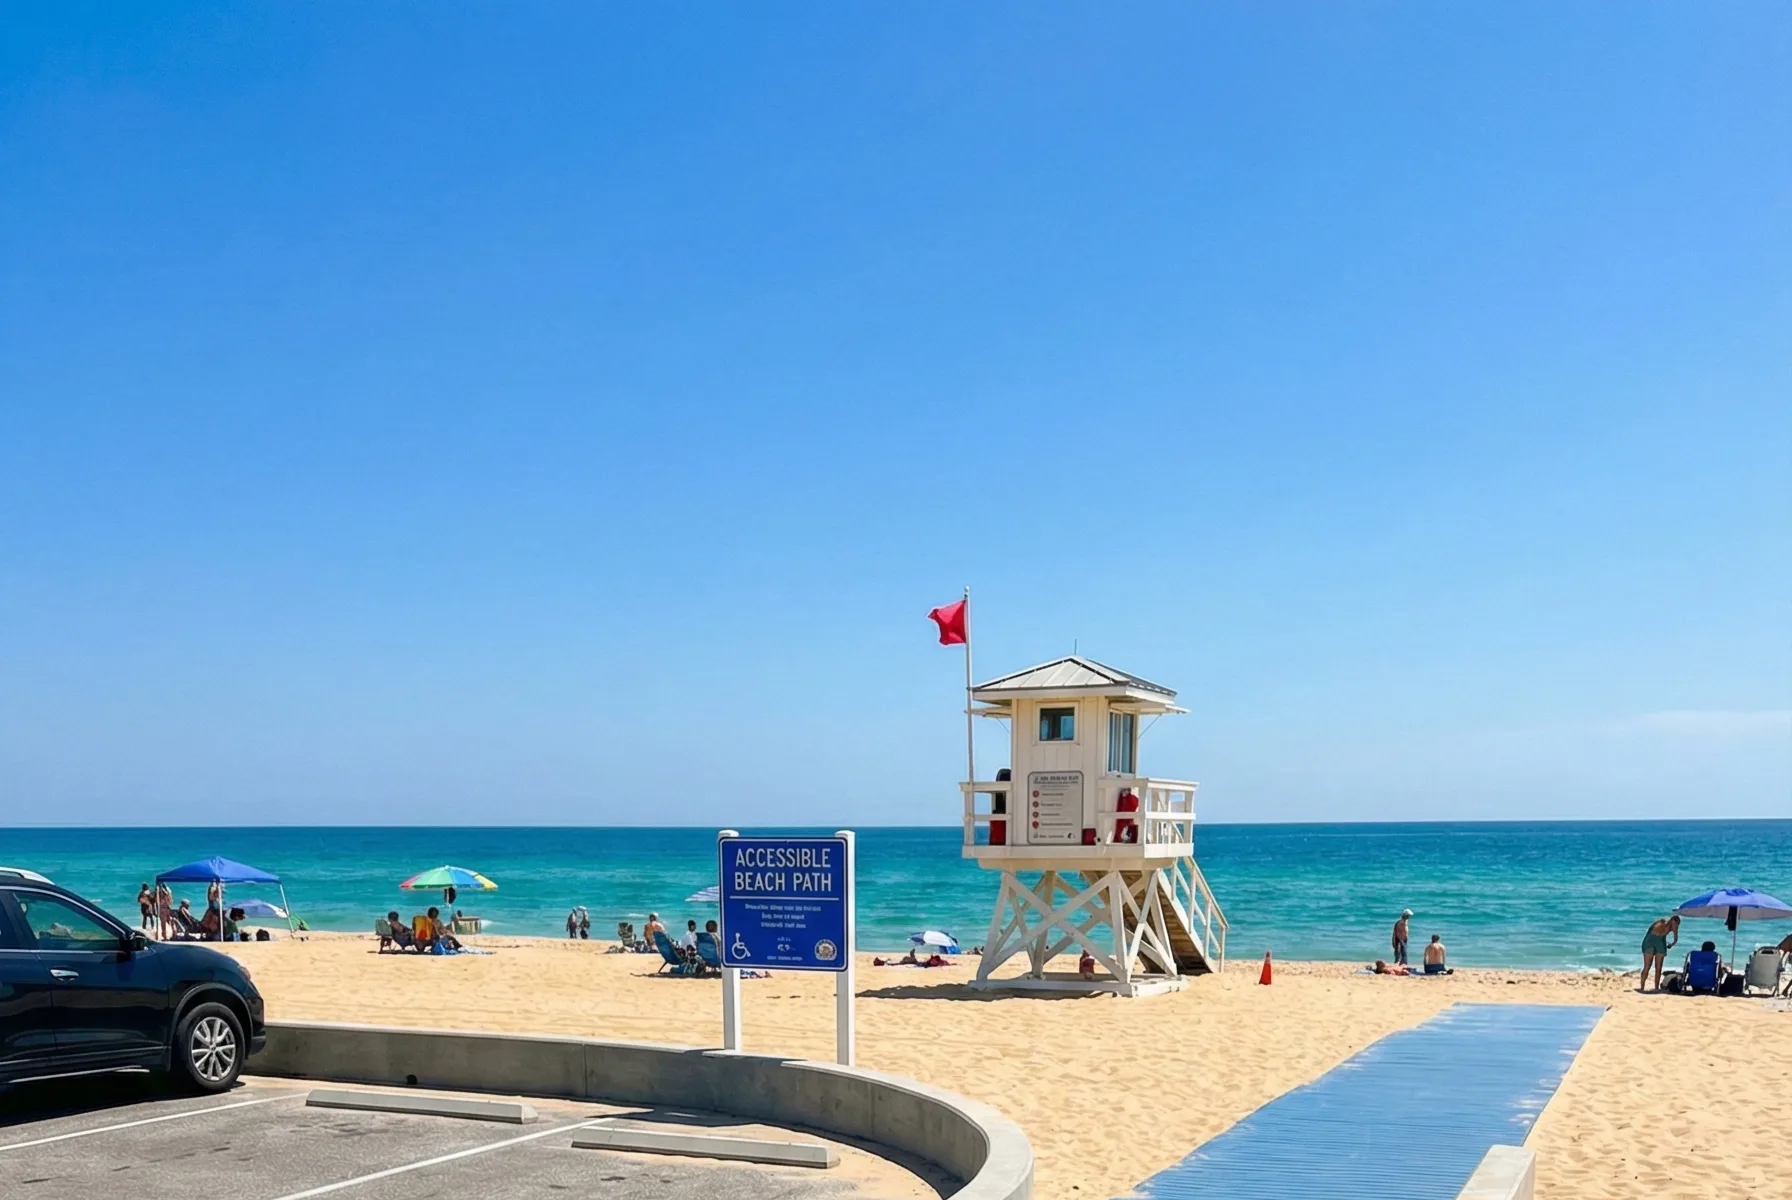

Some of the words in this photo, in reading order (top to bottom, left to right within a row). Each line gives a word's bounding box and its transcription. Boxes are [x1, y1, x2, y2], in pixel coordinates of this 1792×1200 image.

[735, 847, 831, 868] ACCESSIBLE
[734, 871, 785, 891] BEACH
[793, 872, 832, 892] PATH
